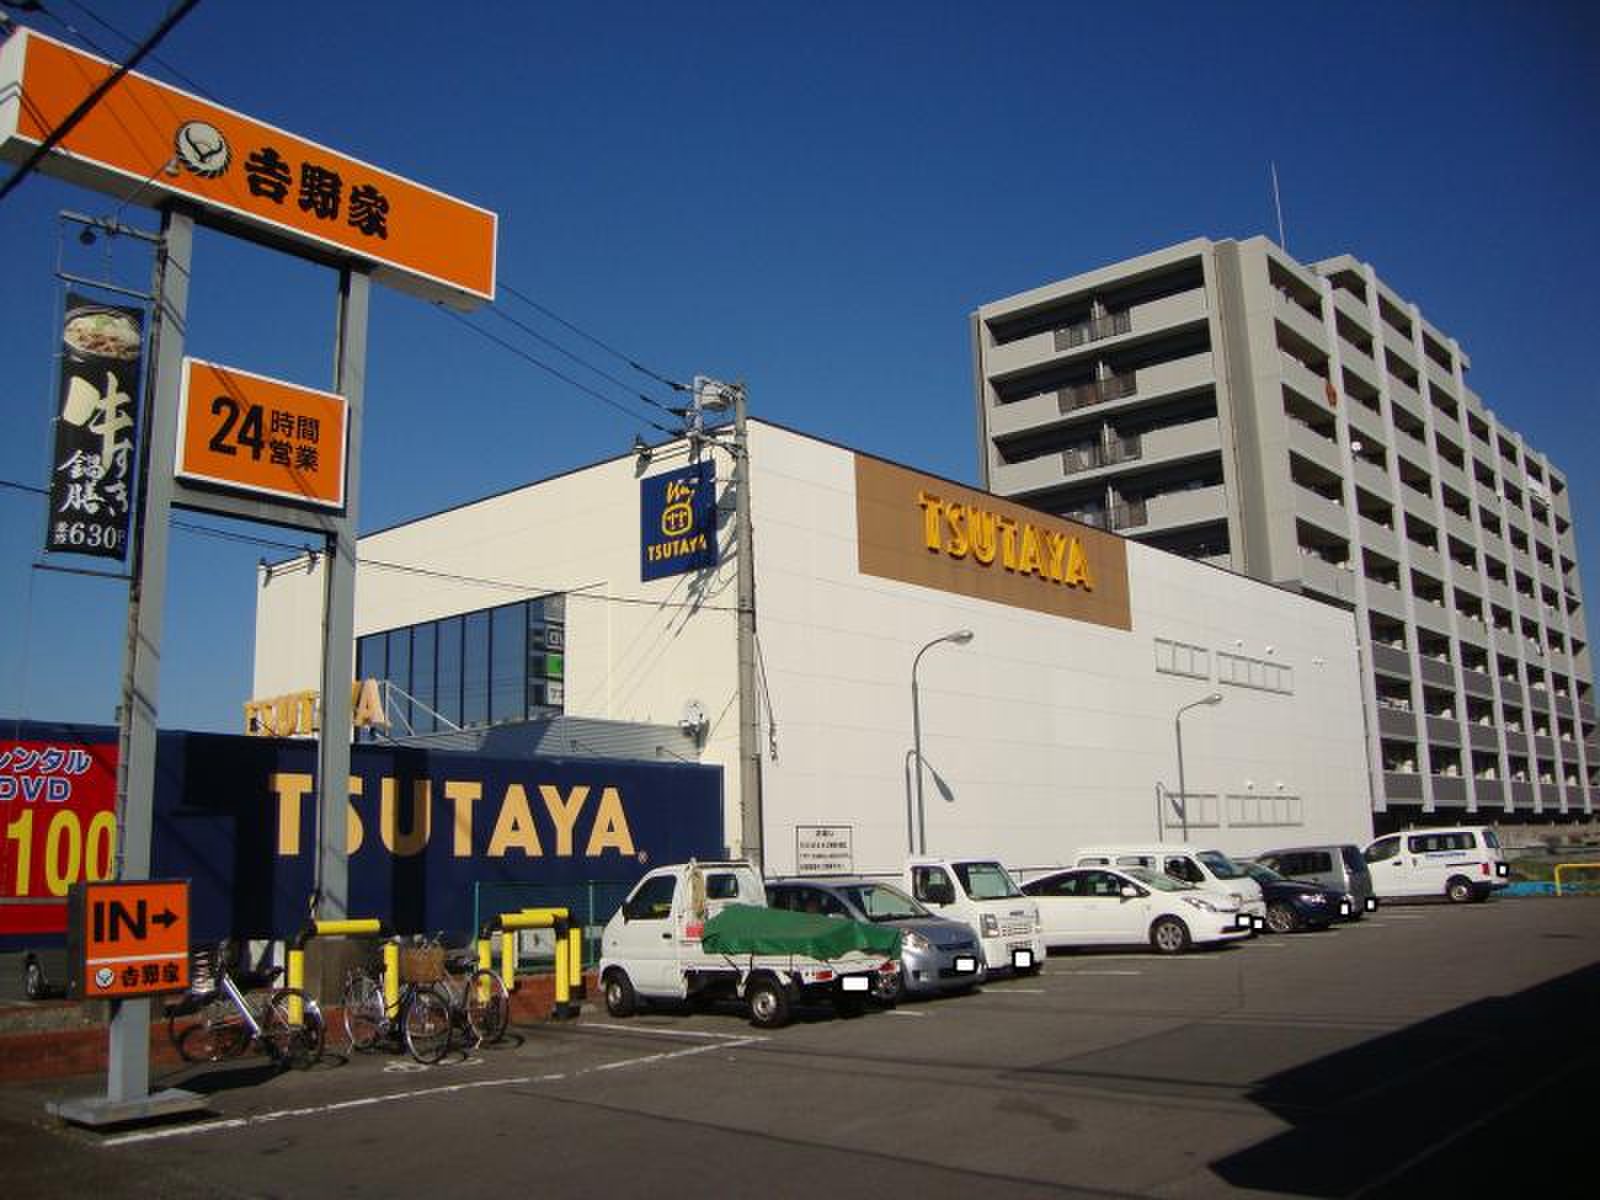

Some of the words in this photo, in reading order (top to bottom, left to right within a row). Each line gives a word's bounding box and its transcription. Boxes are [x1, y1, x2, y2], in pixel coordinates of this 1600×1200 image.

[245, 147, 390, 240] 吉野家
[208, 395, 264, 462] 24
[271, 410, 320, 444] 時間
[270, 440, 319, 473] 営業
[648, 533, 707, 561] TSUTAYA
[915, 490, 1094, 592] TSUTAYA
[0, 775, 73, 802] DVD
[7, 809, 118, 897] 100
[94, 900, 147, 943] IN
